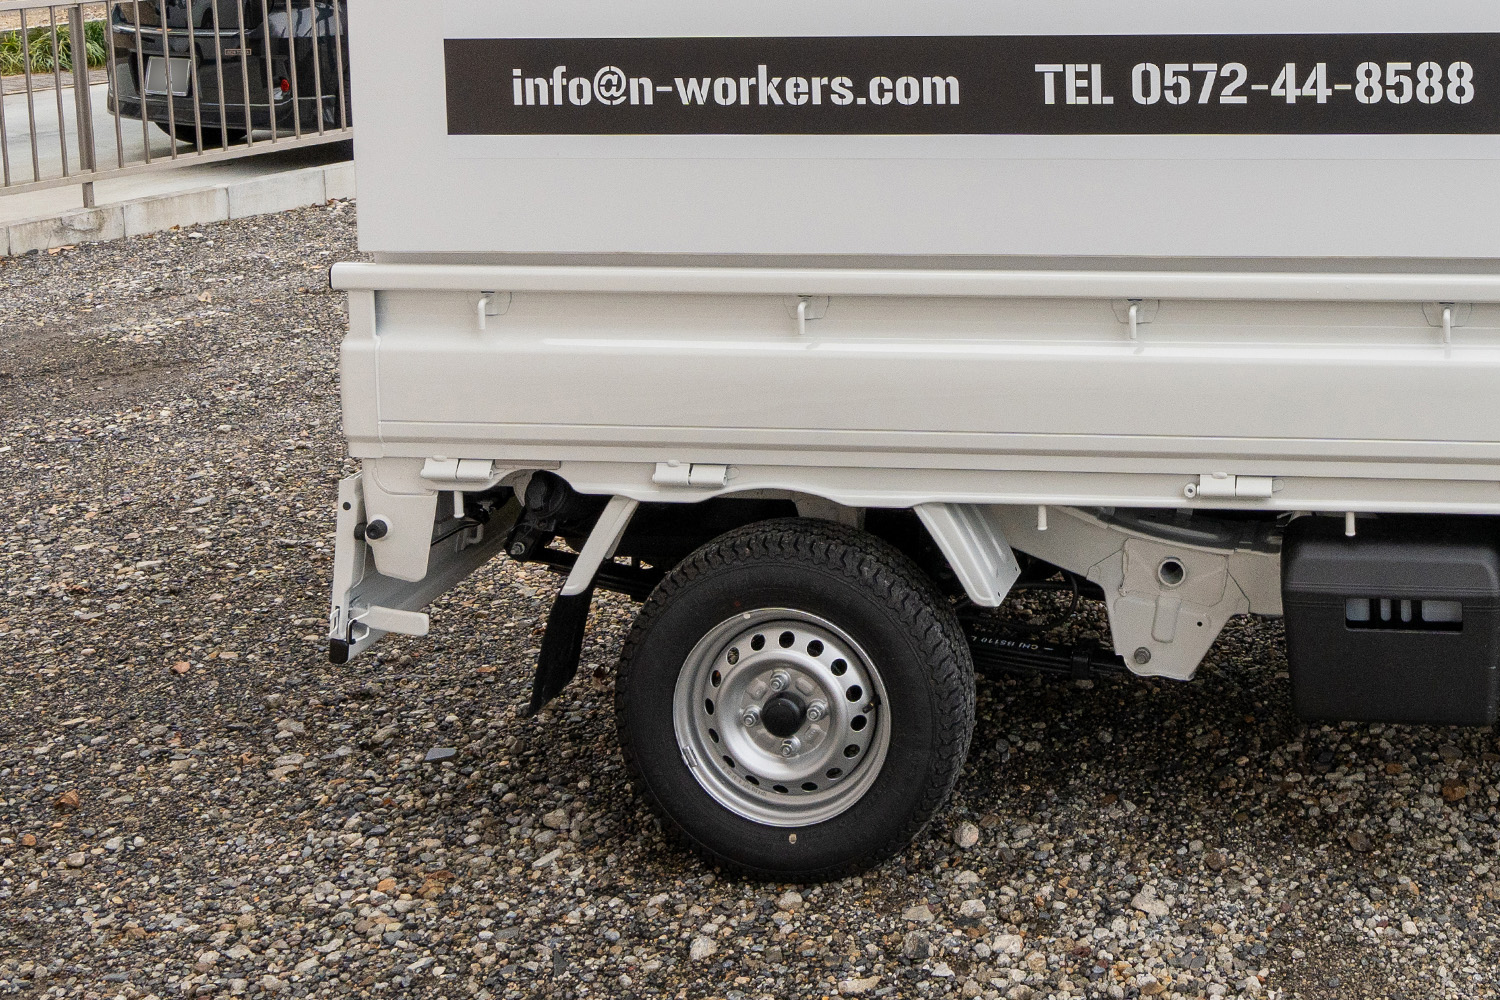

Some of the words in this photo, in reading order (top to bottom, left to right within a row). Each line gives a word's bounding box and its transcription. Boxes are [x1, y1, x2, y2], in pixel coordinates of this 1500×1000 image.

[512, 64, 960, 106] info@n-workers.com
[1034, 63, 1114, 105] TEL
[1131, 61, 1475, 105] 0572-44-8588
